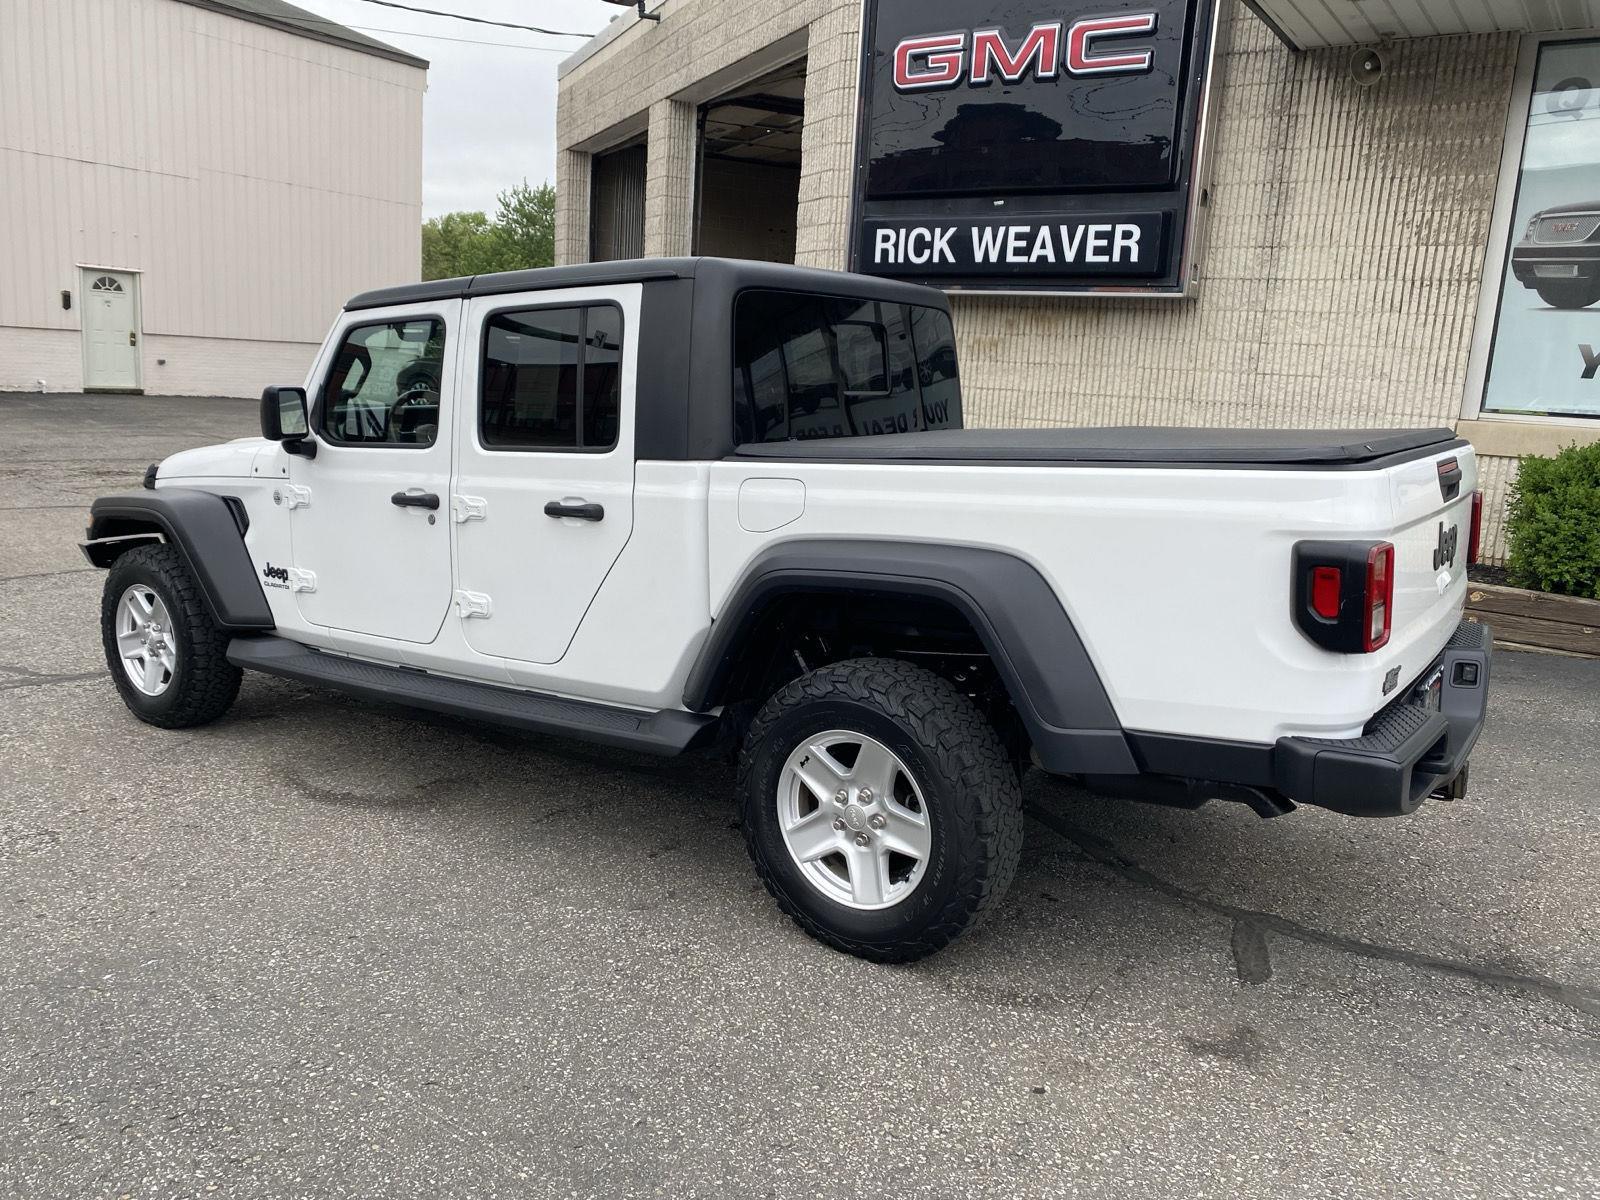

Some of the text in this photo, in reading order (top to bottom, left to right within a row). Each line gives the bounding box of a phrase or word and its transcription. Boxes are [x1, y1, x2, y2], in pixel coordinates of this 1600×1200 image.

[894, 13, 1156, 89] GMC
[874, 223, 1141, 264] RICK WEAVER
[1433, 521, 1458, 571] Jeep
[263, 561, 289, 583] Jeep
